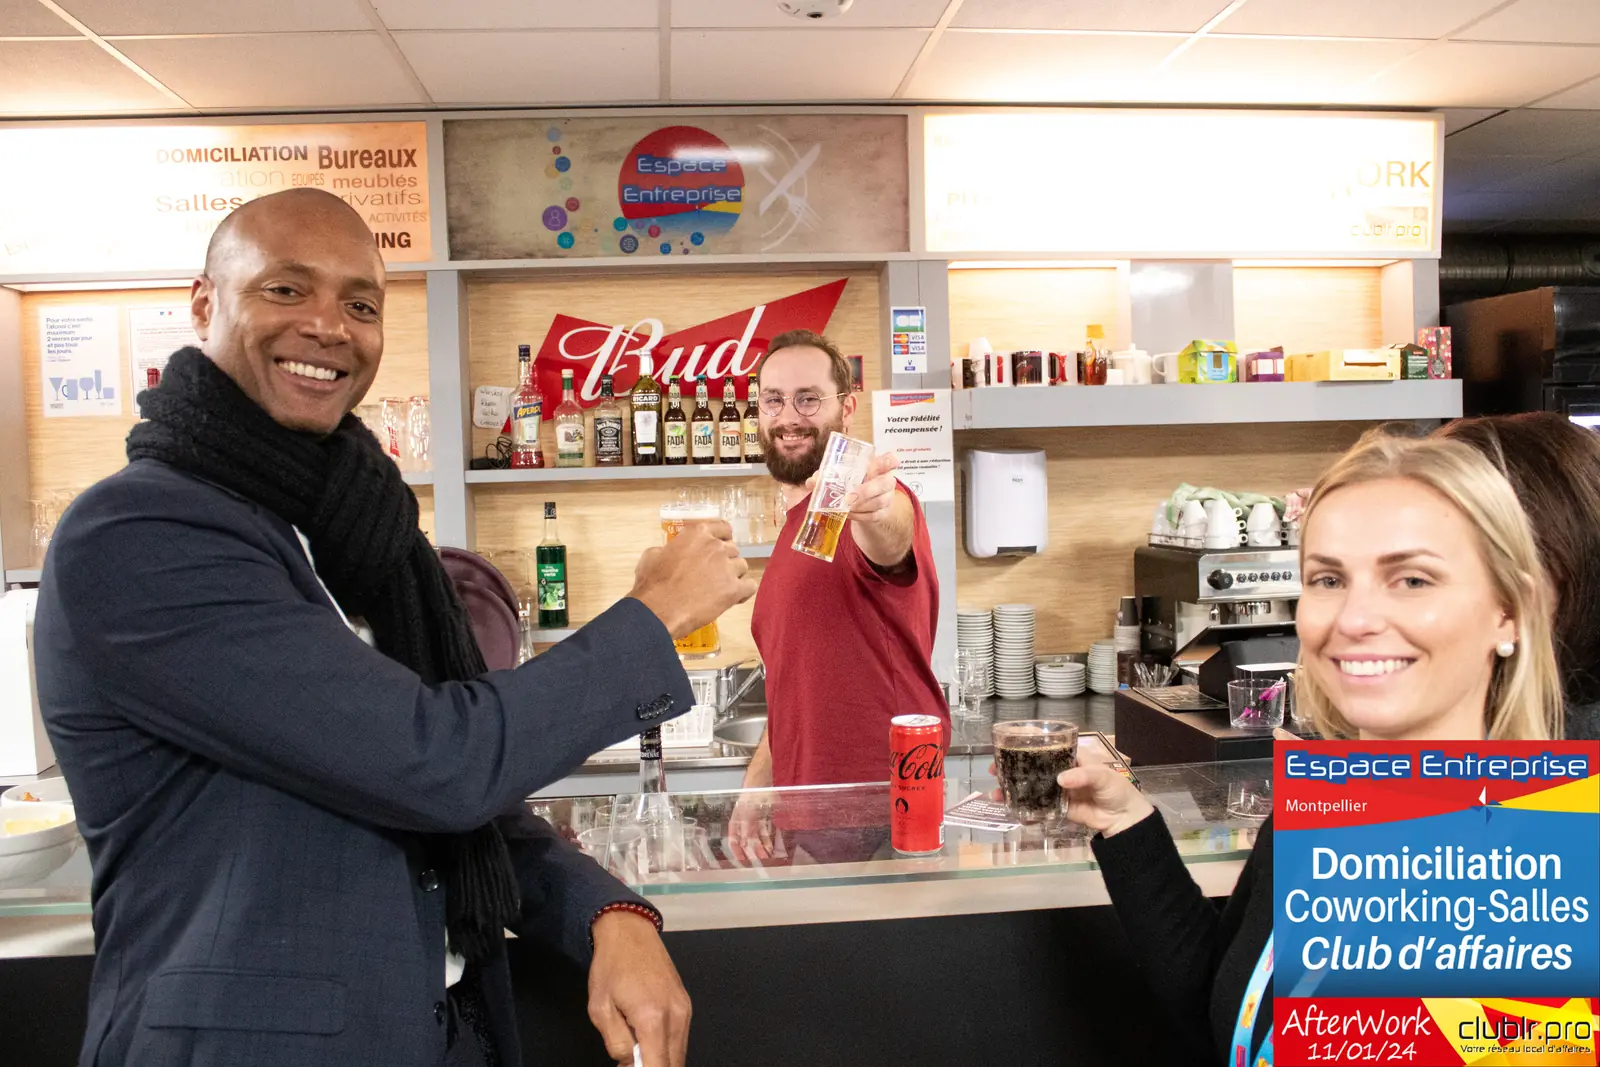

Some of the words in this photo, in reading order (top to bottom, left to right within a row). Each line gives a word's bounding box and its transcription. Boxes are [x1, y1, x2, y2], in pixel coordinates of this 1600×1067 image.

[156, 145, 308, 163] DOMICILIATION
[318, 145, 417, 170] Bureaux
[637, 156, 727, 176] Espace
[332, 174, 418, 189] meublés
[156, 193, 243, 213] Salles
[343, 189, 421, 207] rivatifs
[623, 186, 741, 205] Entreprise
[368, 210, 428, 224] ACTIVITÉS
[558, 305, 766, 401] Bud
[632, 394, 660, 403] RICARD
[911, 414, 940, 423] Fidélité
[884, 426, 939, 434] récompensée
[667, 435, 685, 446] FADA
[694, 435, 713, 446] FADA
[722, 435, 740, 446] FADA
